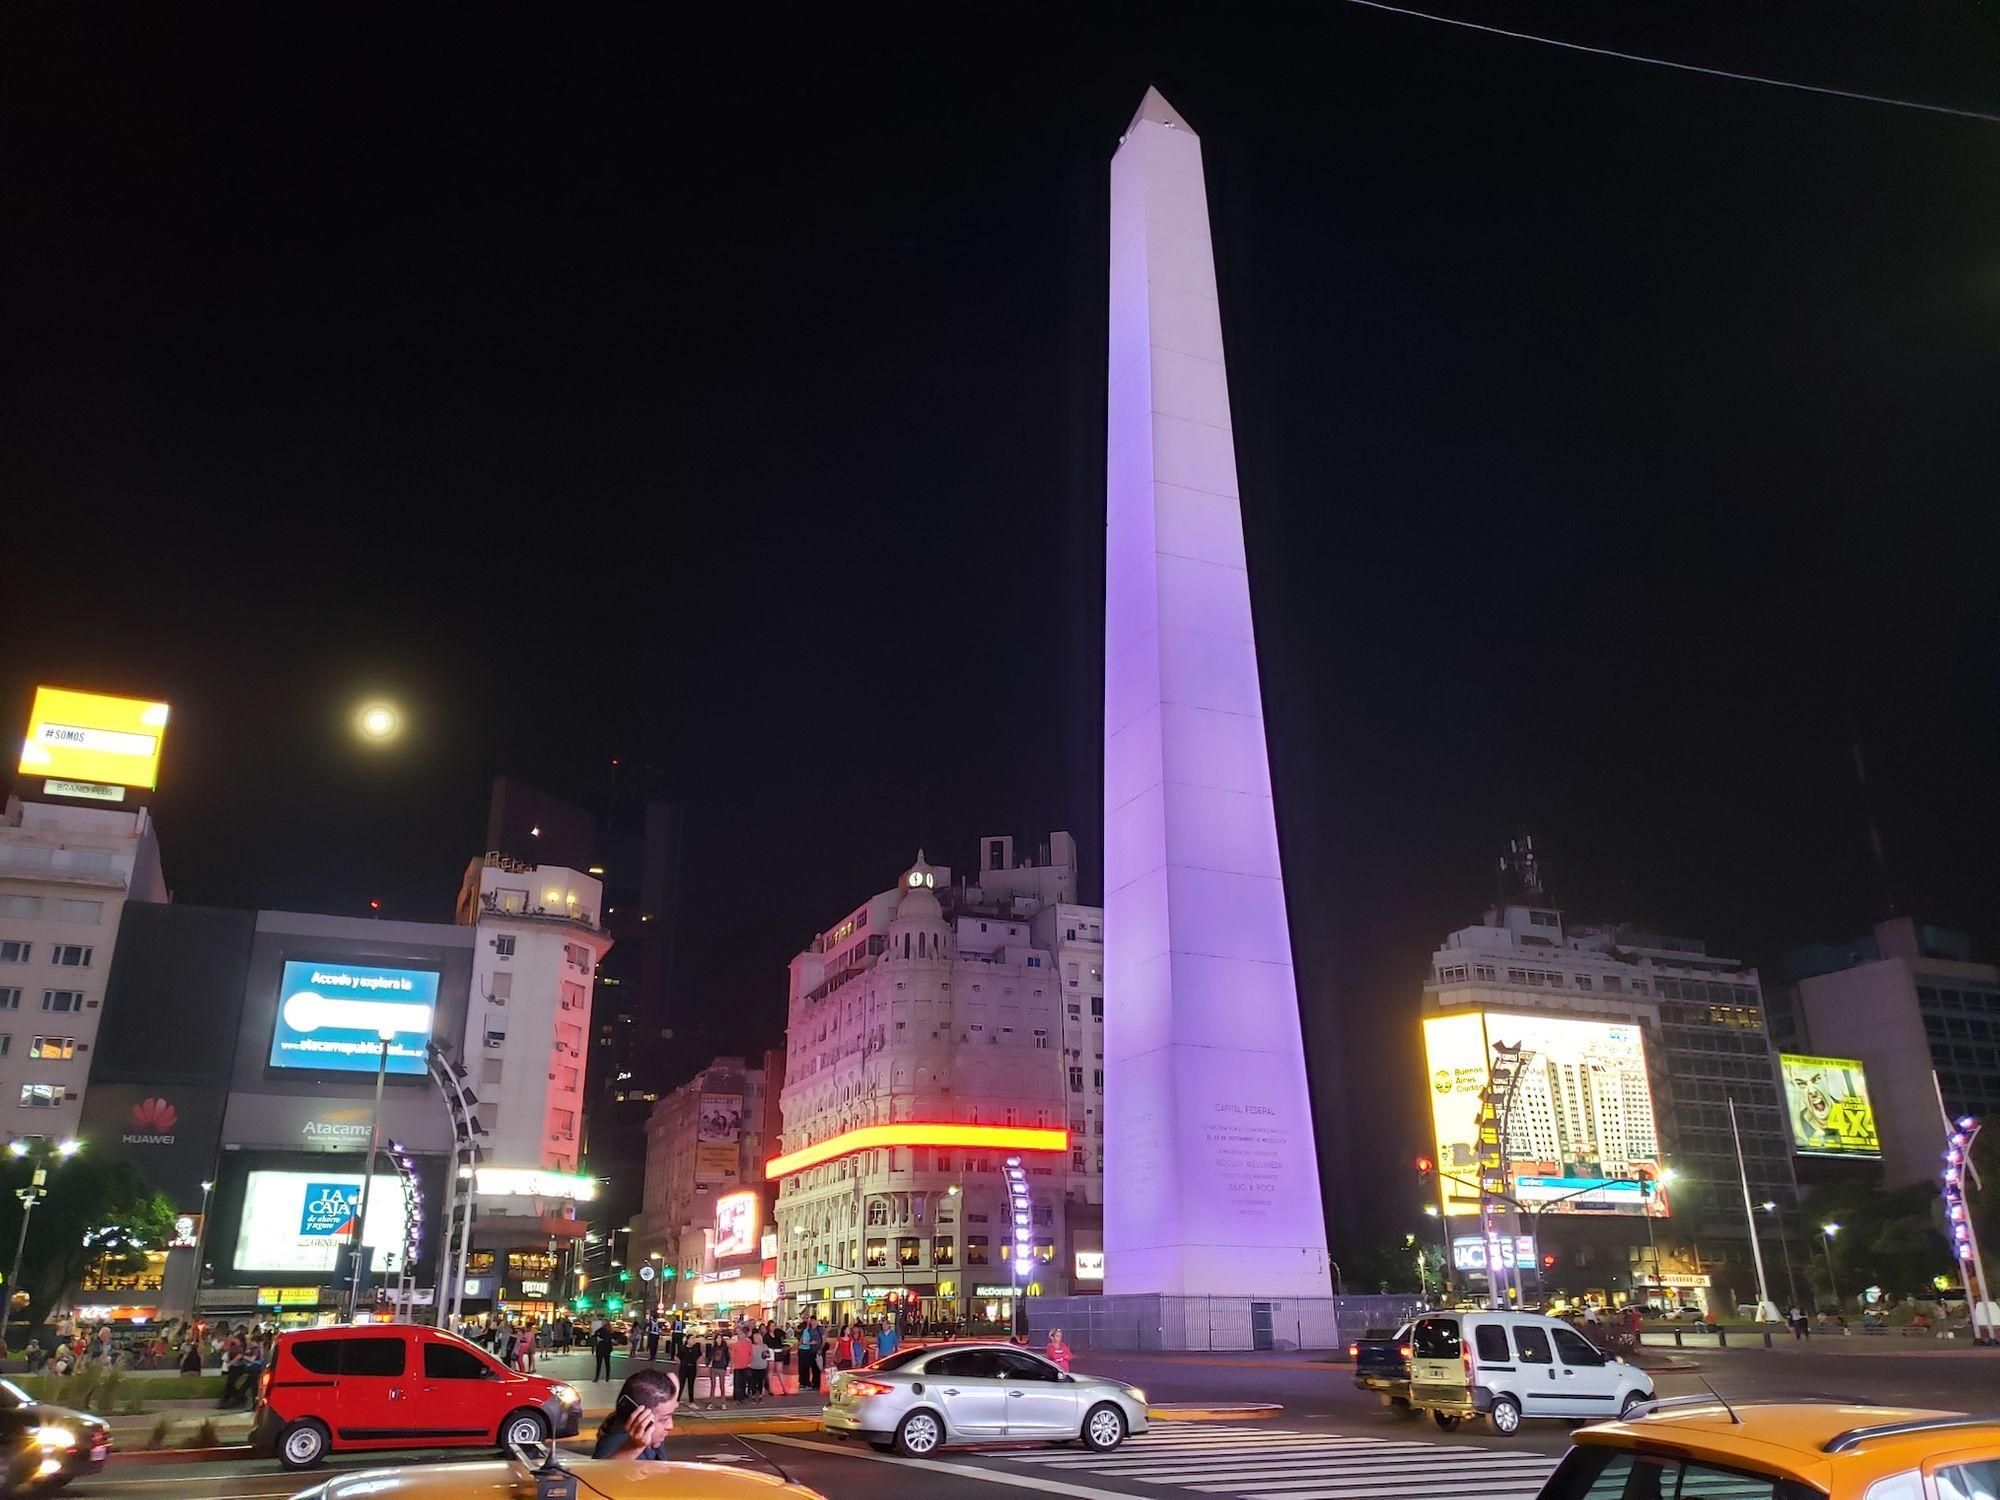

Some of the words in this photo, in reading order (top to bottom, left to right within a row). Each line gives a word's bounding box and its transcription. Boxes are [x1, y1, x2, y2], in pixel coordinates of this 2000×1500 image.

[45, 728, 85, 742] #SOMOS
[353, 976, 360, 989] y
[302, 1121, 373, 1136] Atacama
[122, 1134, 175, 1145] HUAWEI
[320, 1189, 345, 1203] LA
[308, 1200, 351, 1216] CAJA
[79, 1305, 111, 1319] KFC
